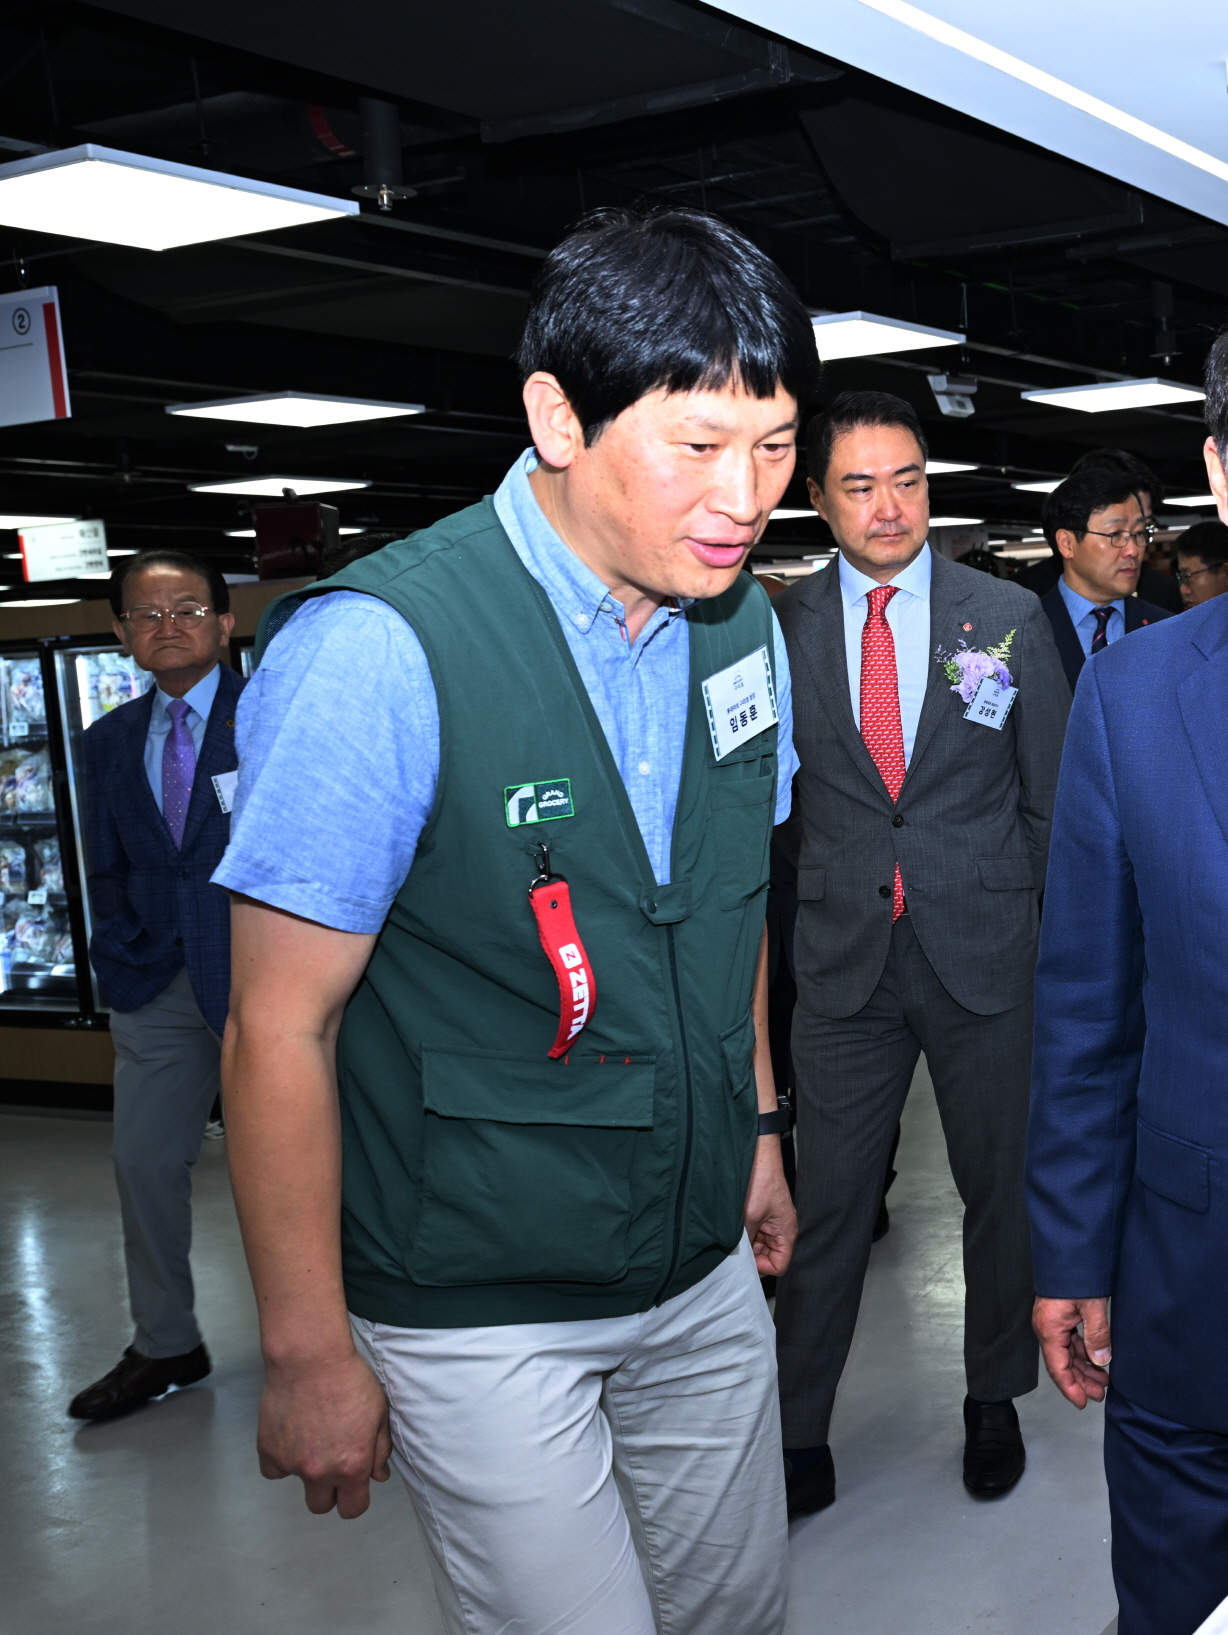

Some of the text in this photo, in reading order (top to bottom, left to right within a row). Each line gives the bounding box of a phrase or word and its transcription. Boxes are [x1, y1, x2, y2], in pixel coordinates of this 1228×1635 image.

[729, 704, 758, 733] 임동훈
[538, 797, 569, 809] GROCERY
[542, 789, 564, 800] GRAND
[567, 967, 590, 1042] ZETTA
